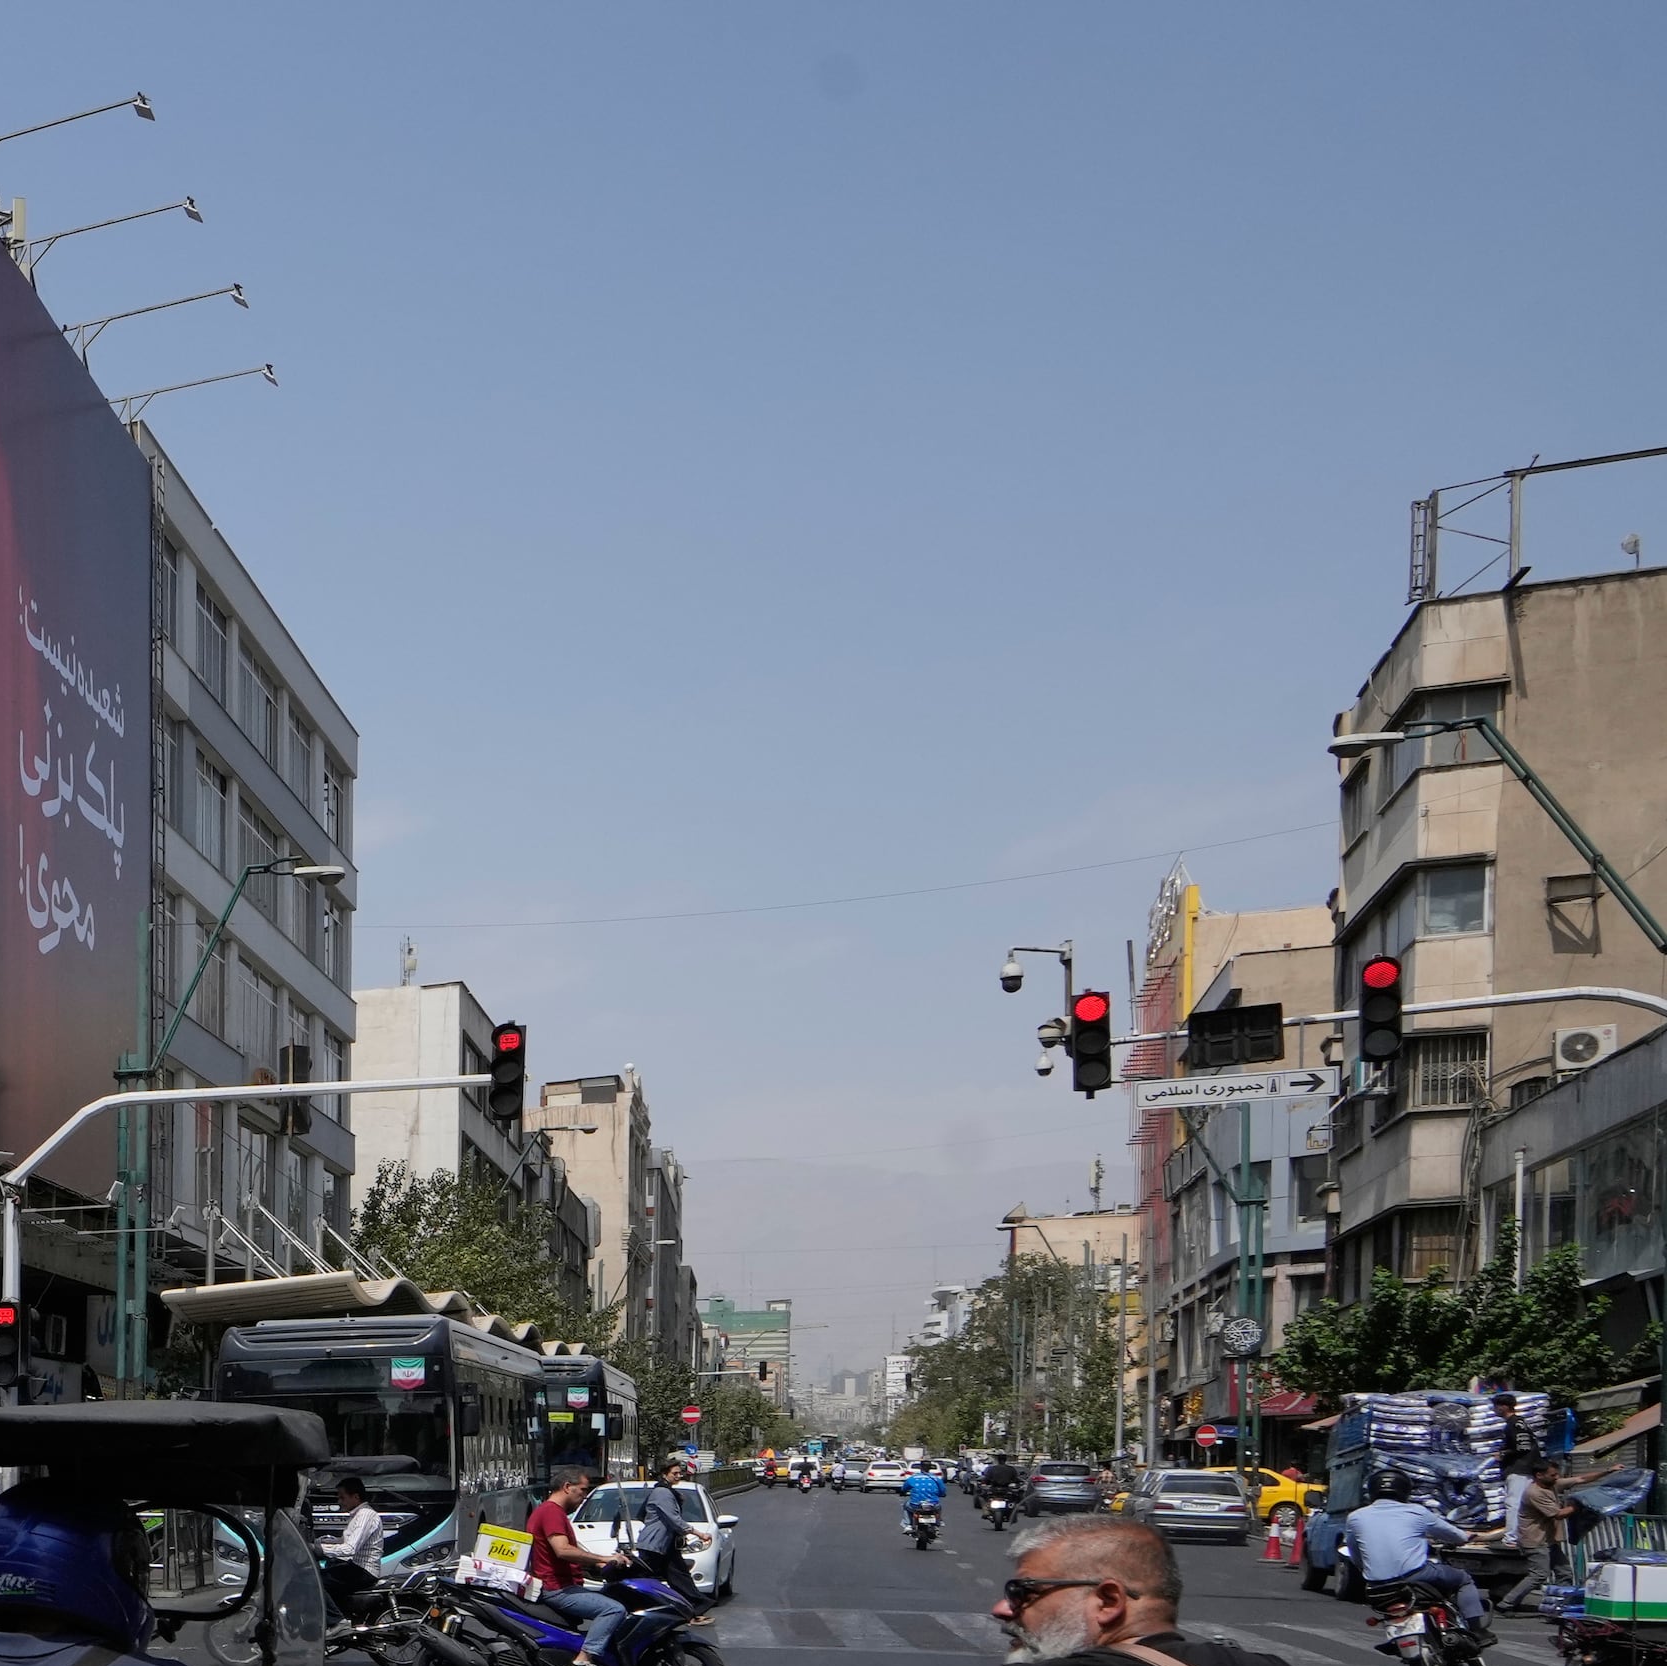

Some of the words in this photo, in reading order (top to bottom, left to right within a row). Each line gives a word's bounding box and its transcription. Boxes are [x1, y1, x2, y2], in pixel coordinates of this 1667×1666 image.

[19, 698, 75, 829] بزنی
[77, 741, 125, 881] پلک
[1145, 1084, 1200, 1102] اسلامی
[1203, 1081, 1265, 1098] جمهوری
[488, 1544, 517, 1558] plus
